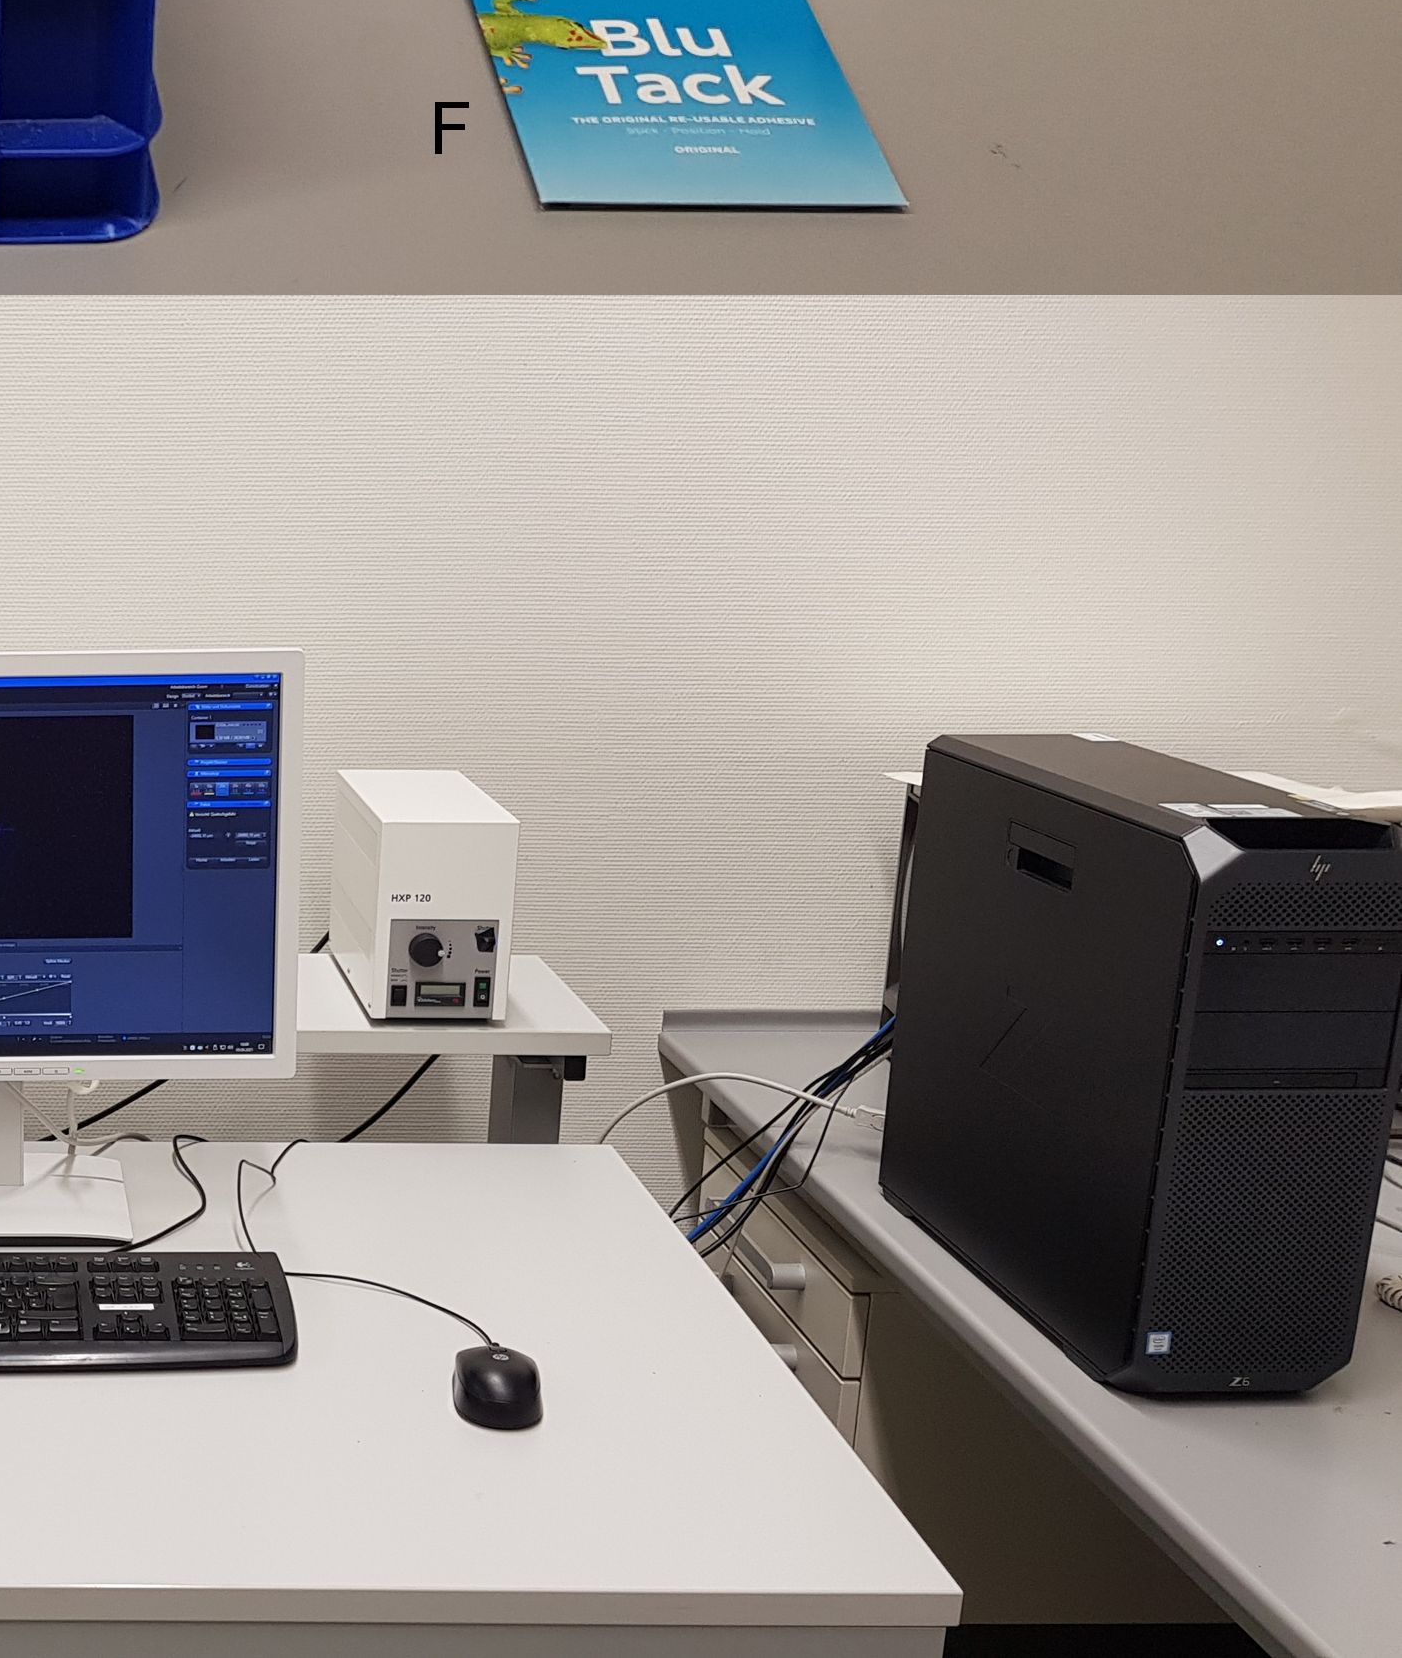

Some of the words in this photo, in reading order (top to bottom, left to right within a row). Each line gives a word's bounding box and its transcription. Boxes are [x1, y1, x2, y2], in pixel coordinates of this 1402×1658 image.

[590, 18, 733, 57] Blu
[575, 64, 786, 105] Tack
[571, 116, 599, 125] THE
[601, 116, 667, 125] ORIGINAL
[668, 116, 745, 125] RE-USABLE
[748, 117, 816, 126] ADHESIVE
[671, 126, 726, 135] Position
[674, 145, 740, 154] ORIGINAL
[1310, 855, 1331, 882] hp
[391, 894, 411, 902] HXP
[415, 894, 431, 902] 120
[1229, 1377, 1250, 1387] Z6
